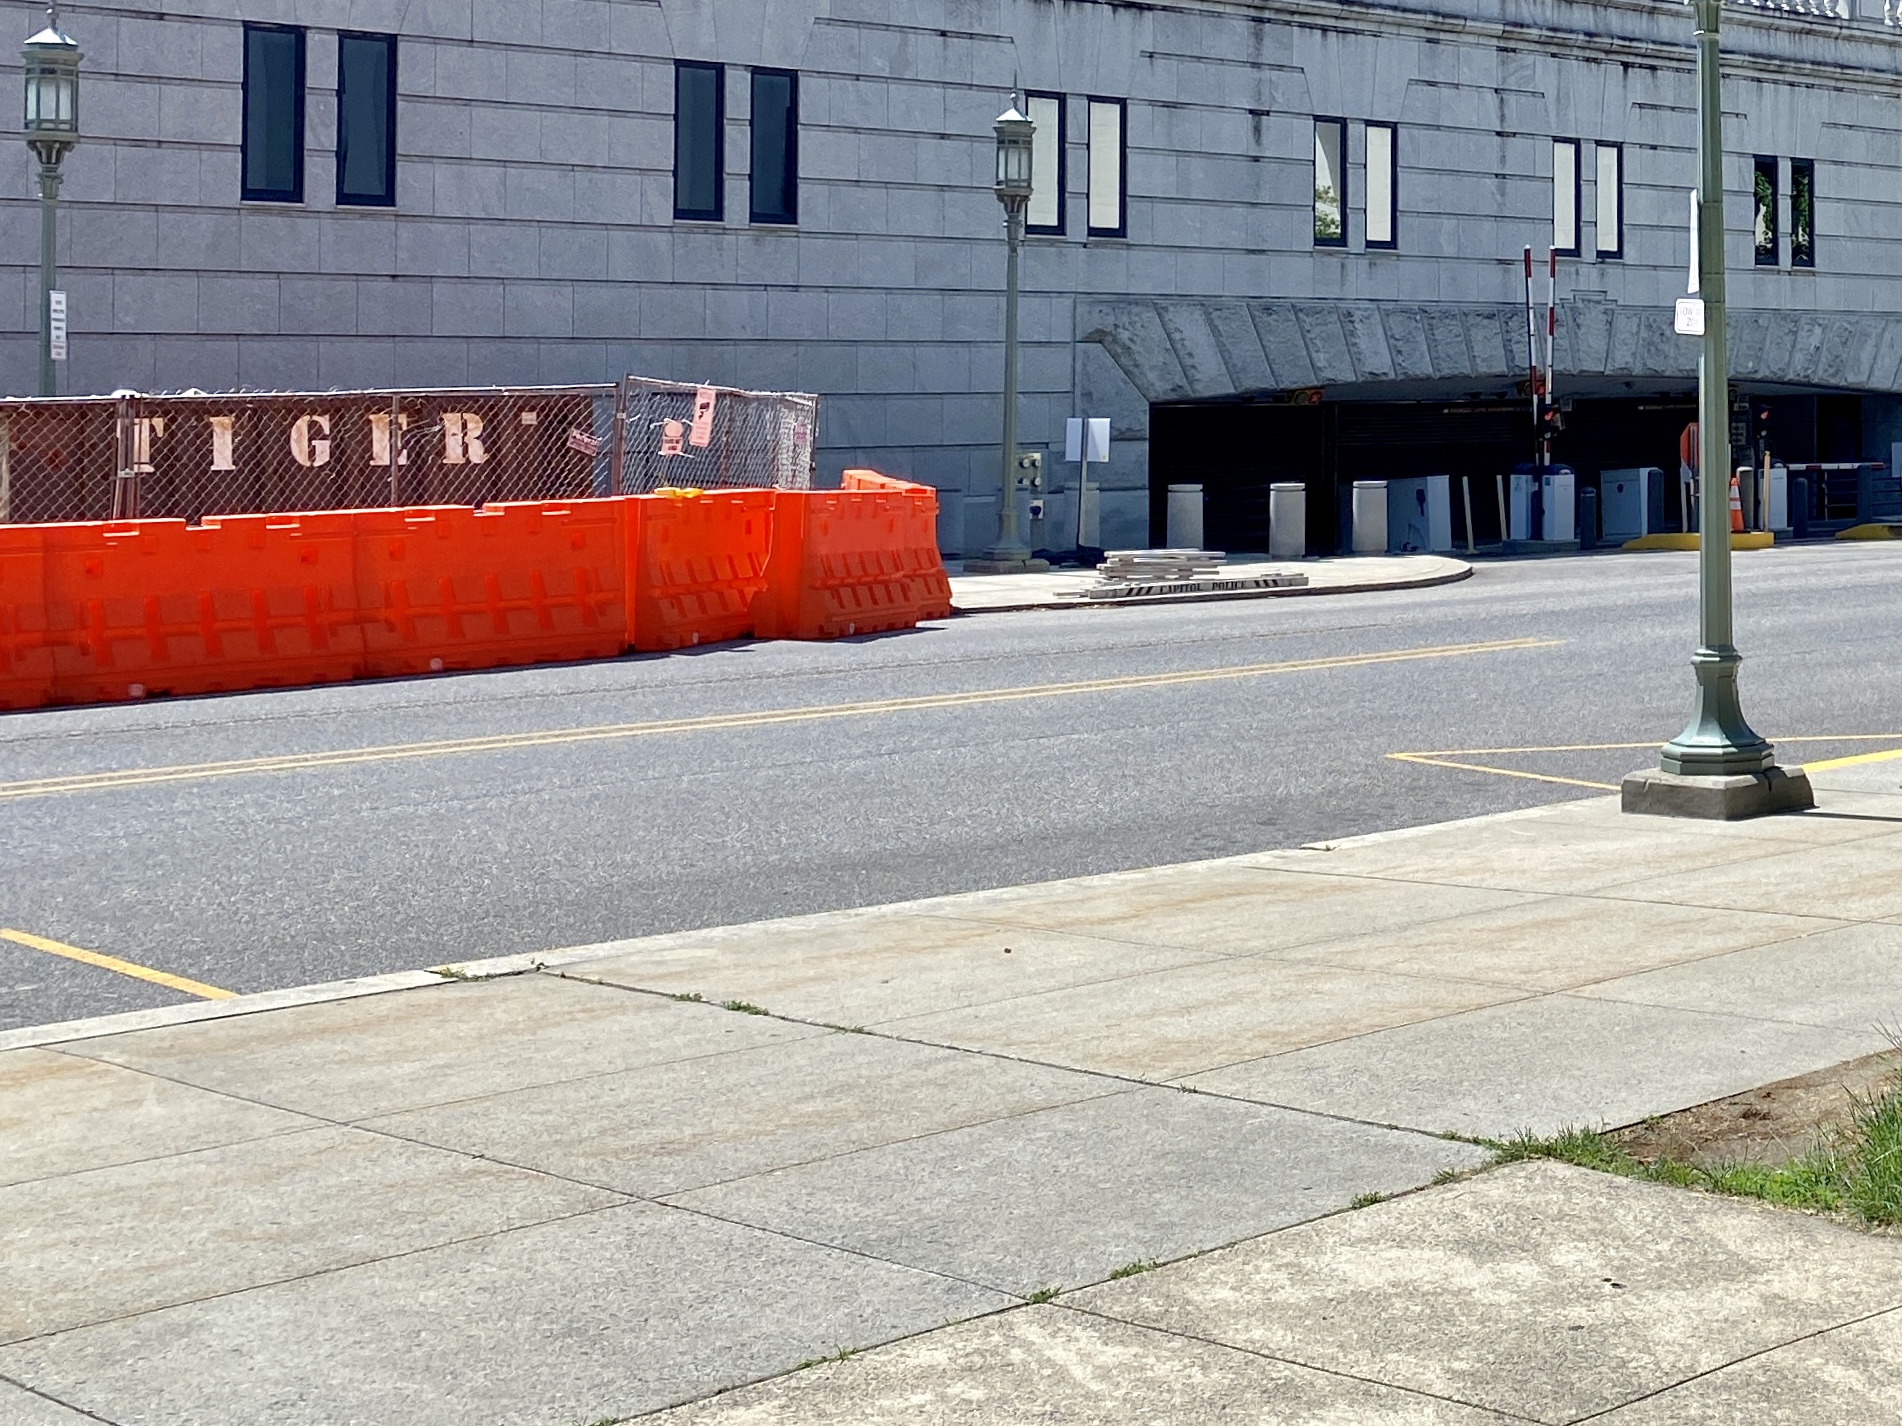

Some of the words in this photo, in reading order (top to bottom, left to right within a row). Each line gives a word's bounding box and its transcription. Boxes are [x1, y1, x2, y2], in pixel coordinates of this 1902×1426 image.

[117, 412, 490, 473] TIGER
[1160, 582, 1202, 594] CAPITOL
[1211, 580, 1247, 591] POLICE
